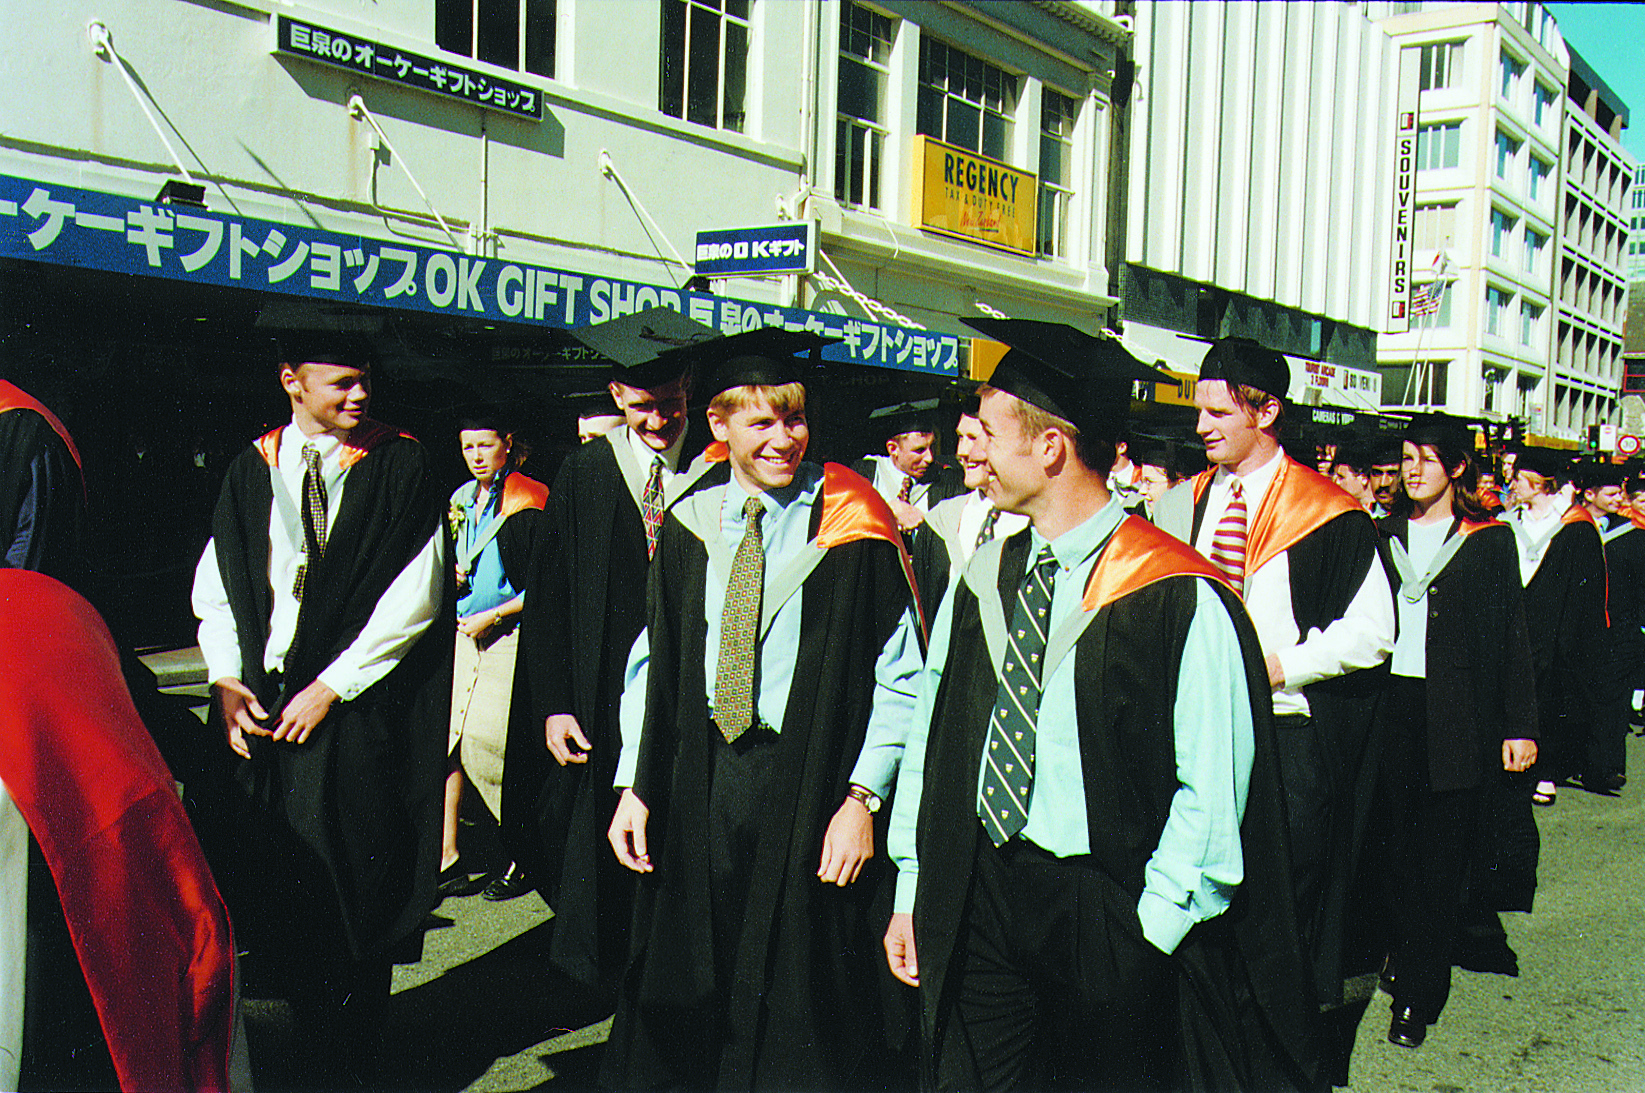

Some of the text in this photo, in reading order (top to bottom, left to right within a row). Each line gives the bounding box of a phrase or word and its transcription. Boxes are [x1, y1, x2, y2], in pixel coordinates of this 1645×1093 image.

[290, 23, 535, 112] 巨泉のオーケーギフトショップ
[945, 152, 1019, 204] REGENCY
[945, 187, 960, 201] TAX
[973, 195, 993, 211] DUTY
[997, 202, 1016, 218] FREE
[1395, 139, 1411, 293] SOUVENIRS
[425, 253, 487, 312] OK
[497, 265, 583, 324] GIFT
[1178, 378, 1198, 400] DUT
